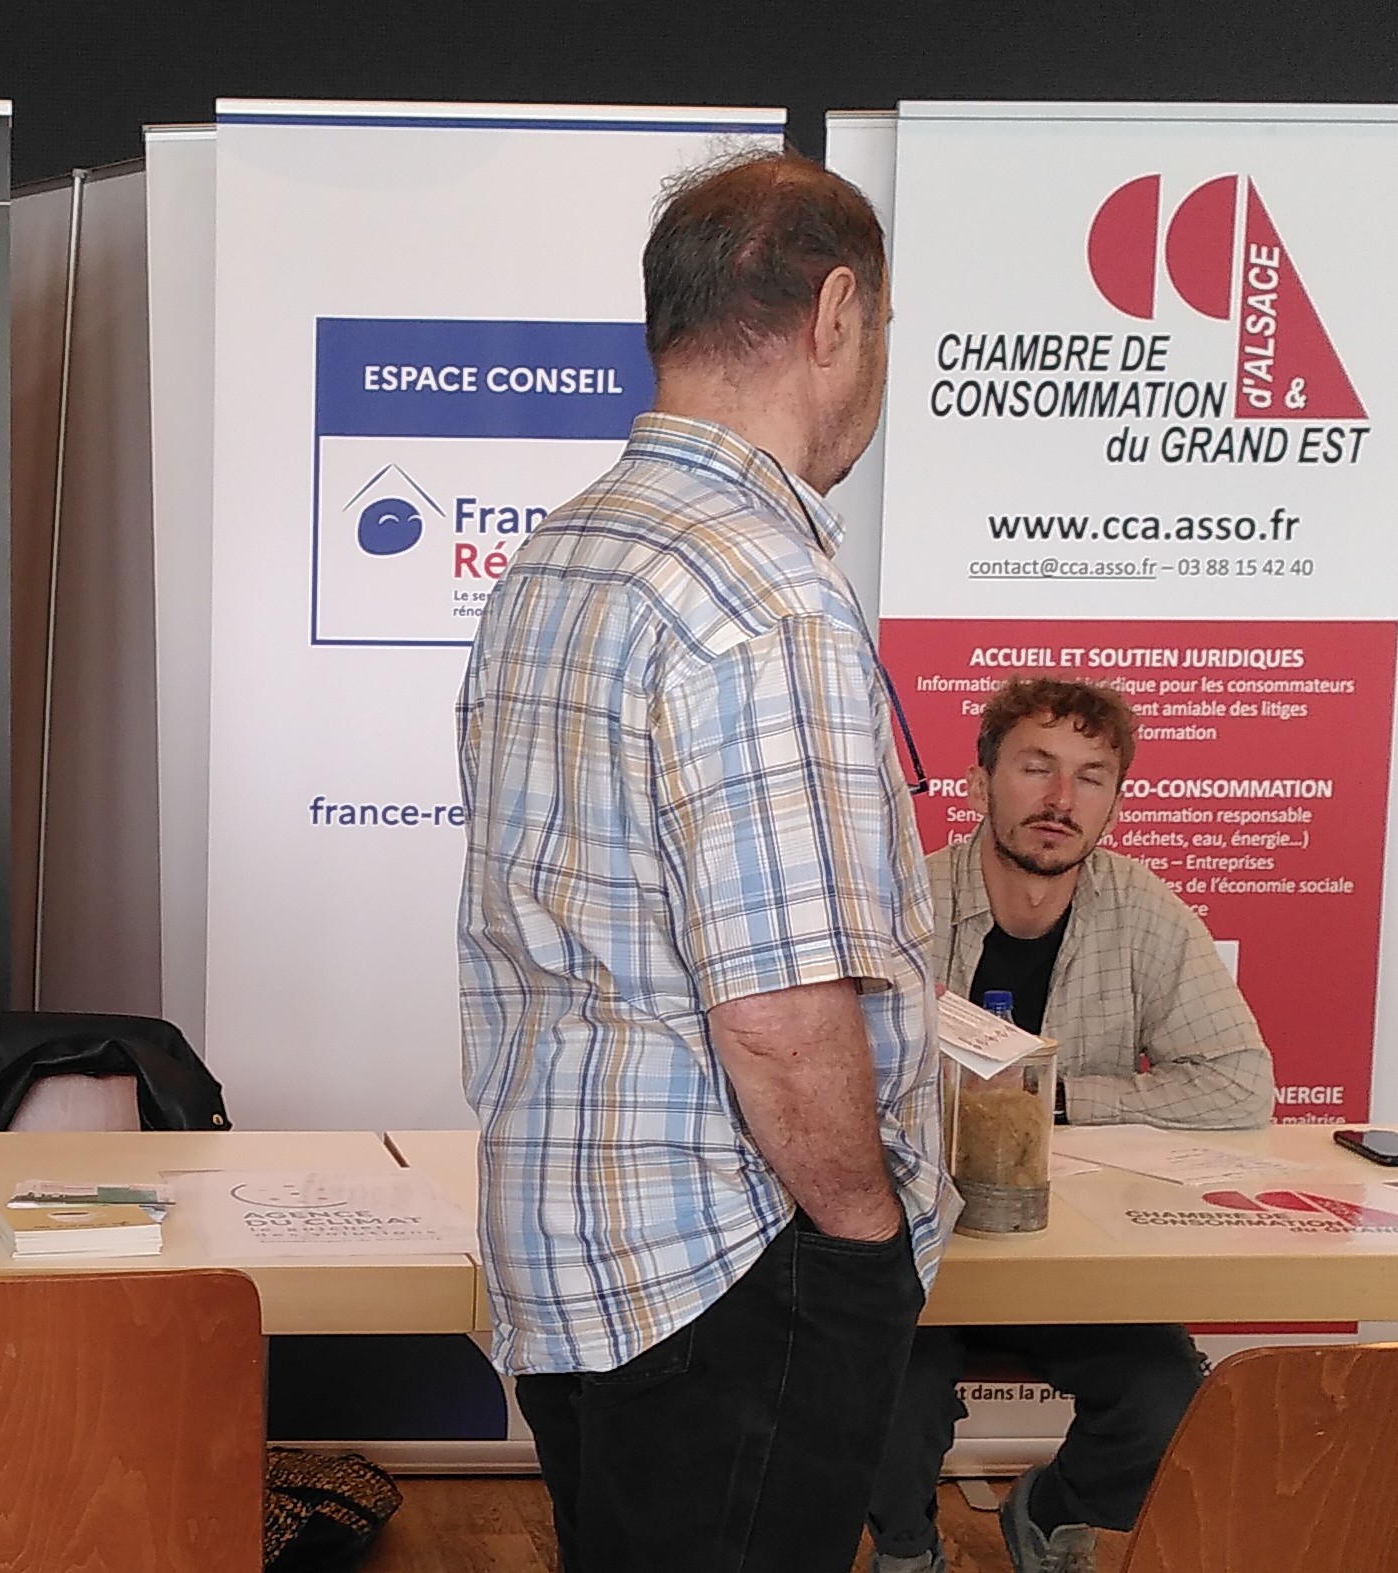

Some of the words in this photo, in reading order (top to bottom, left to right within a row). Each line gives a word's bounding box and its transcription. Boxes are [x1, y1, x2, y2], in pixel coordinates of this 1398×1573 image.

[1242, 243, 1281, 410] d'ALSACE
[937, 332, 1113, 372] CHAMBRE
[1119, 334, 1170, 372] DE
[363, 364, 478, 394] ESPACE
[486, 365, 623, 395] CONSEIL
[930, 379, 1227, 419] CONSOMMATION
[1105, 425, 1150, 463] du
[1160, 425, 1288, 463] GRAND
[1297, 426, 1371, 464] EST
[454, 497, 548, 535] Fran
[987, 506, 1300, 541] www.cca.asso.fr
[967, 556, 1157, 577] contact@cca.asso.fr
[1177, 557, 1200, 576] 03
[1205, 557, 1229, 576] 88
[1234, 558, 1257, 576] 15
[1261, 558, 1285, 576] 42
[1289, 558, 1314, 576] 40
[453, 590, 470, 602] Le
[969, 647, 1056, 667] ACCUEIL
[1059, 647, 1085, 667] ET
[1087, 647, 1178, 667] SOUTIEN
[1181, 648, 1304, 670] JURIDIQUES
[1158, 679, 1198, 696] pour
[1200, 675, 1224, 693] les
[1226, 678, 1355, 693] consommateurs
[1161, 699, 1226, 717] amiable
[1228, 699, 1258, 717] des
[1260, 699, 1308, 720] litiges
[1121, 779, 1334, 799] CO-CONSOMMATION
[308, 796, 467, 827] france-re
[1216, 805, 1312, 826] responsable
[1121, 828, 1189, 848] déchets,
[1191, 833, 1227, 849] eau,
[1185, 853, 1275, 873] Entreprises
[1185, 876, 1207, 893] de
[1297, 875, 1354, 893] sociale
[1273, 1085, 1345, 1105] NERGIE
[243, 1210, 373, 1220] AGENCE
[303, 1216, 422, 1227] CLIMAT
[1125, 1210, 1243, 1219] CHAMBRE
[1131, 1217, 1345, 1228] CONSOMMATION
[971, 1384, 1014, 1401] dans
[1019, 1384, 1034, 1400] la
